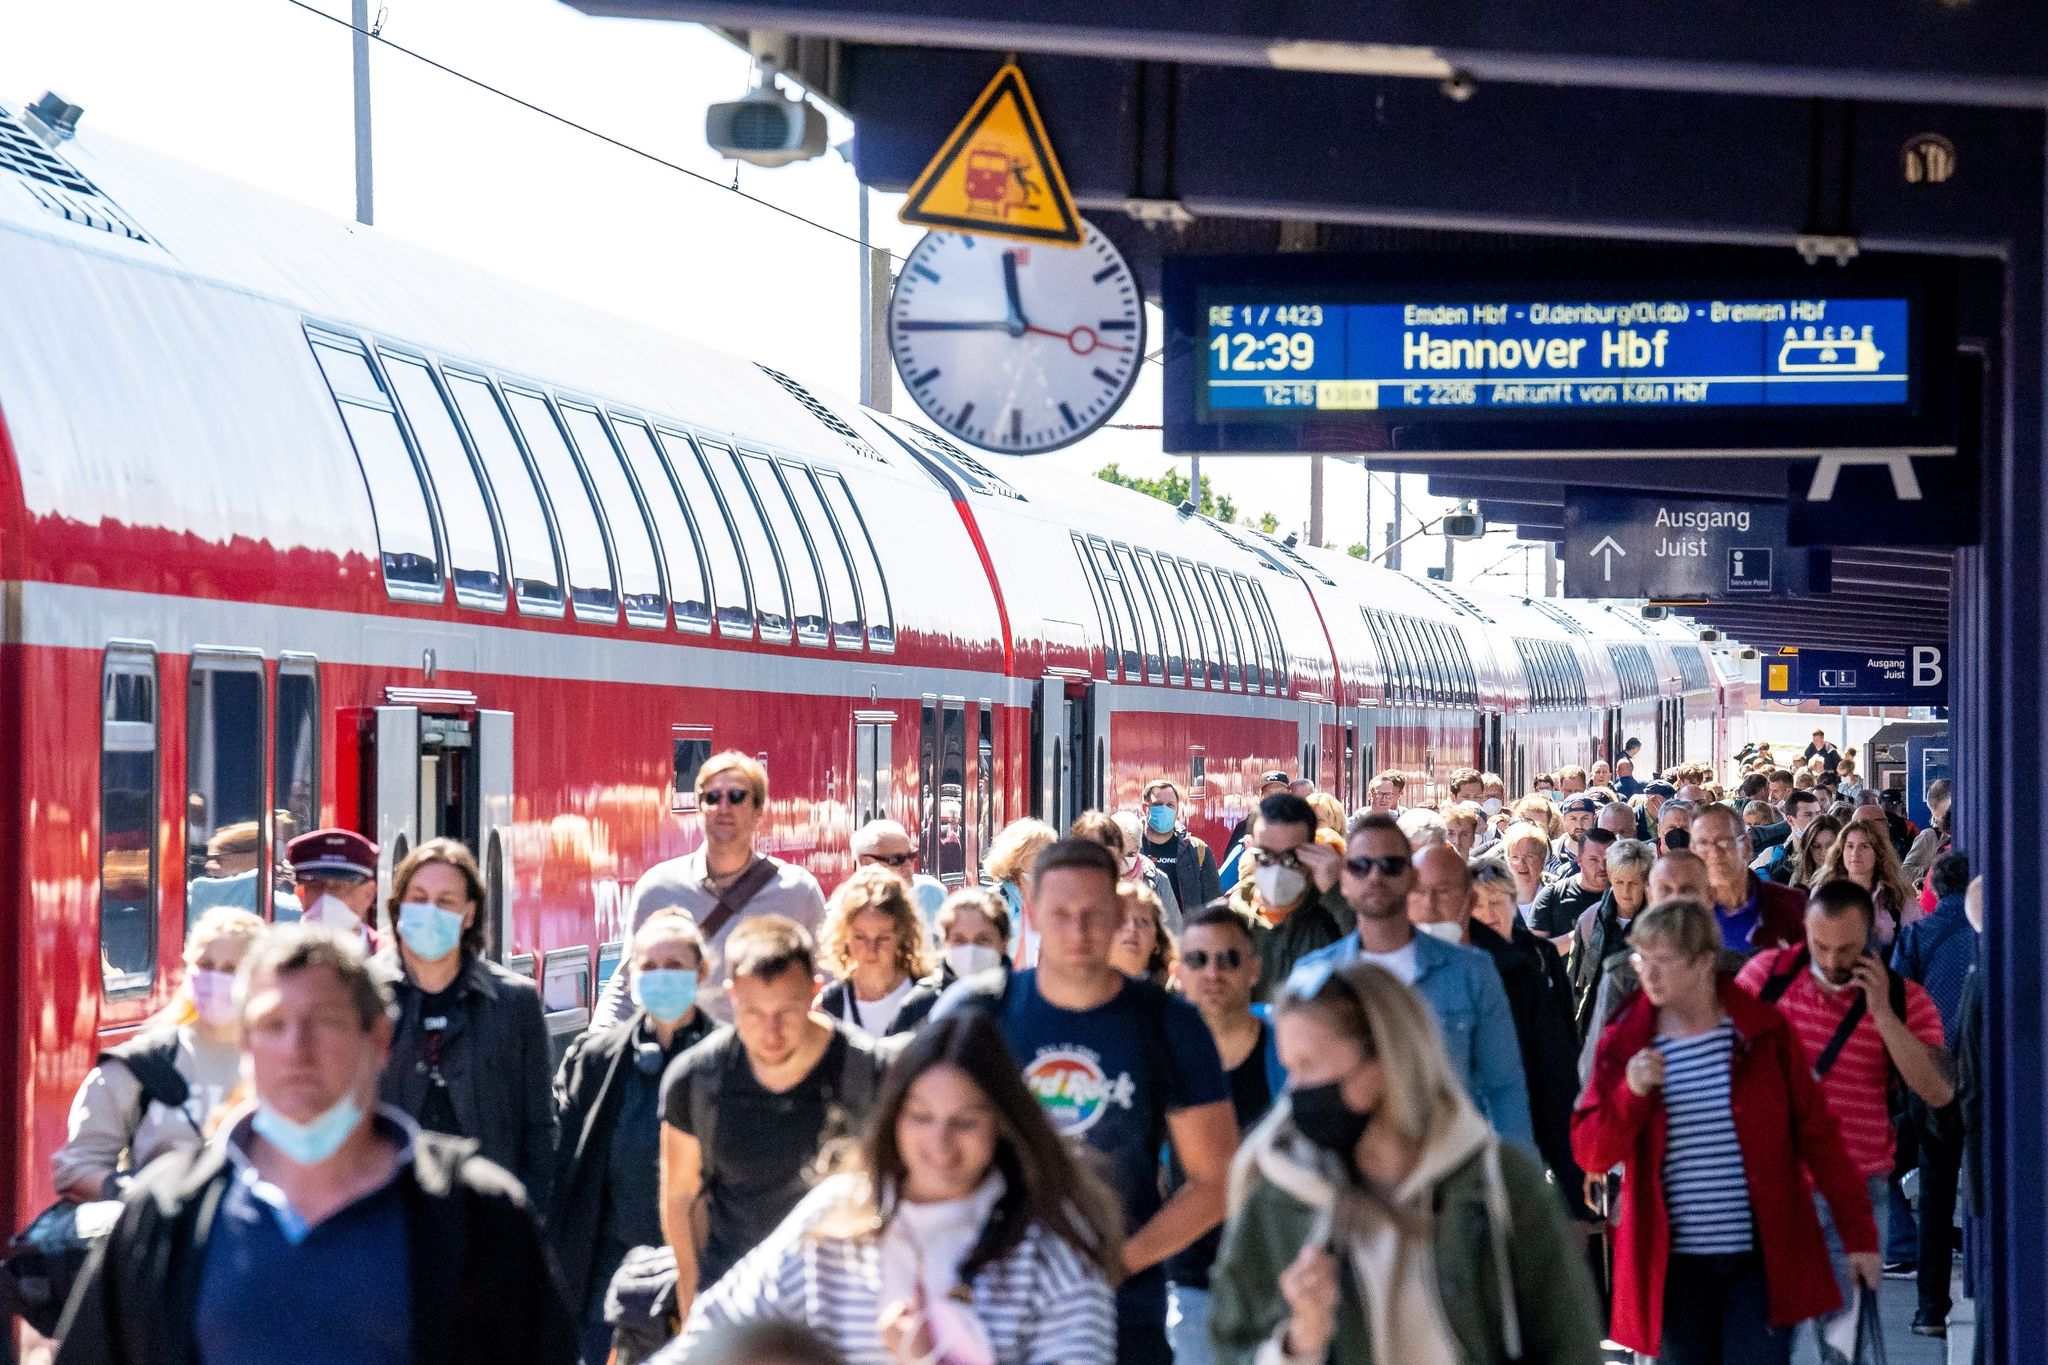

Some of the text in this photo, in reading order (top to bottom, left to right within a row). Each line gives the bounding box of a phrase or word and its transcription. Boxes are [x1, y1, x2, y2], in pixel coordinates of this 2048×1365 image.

[1209, 306, 1234, 327] RE
[1241, 305, 1252, 326] 1
[1275, 305, 1324, 327] 4423
[1404, 305, 1469, 326] Emden
[1473, 303, 1508, 326] Hbf
[1711, 301, 1786, 323] Bremen
[1790, 300, 1827, 322] Hbf
[1209, 332, 1315, 371] 12:39
[1403, 329, 1670, 370] Hannover Hbf
[1403, 384, 1423, 405] IC
[1492, 383, 1573, 404] Ankunft
[1579, 384, 1618, 403] von
[1673, 382, 1709, 402] Hbf
[1654, 507, 1750, 532] Ausgang
[1654, 537, 1708, 557] Juist
[1867, 659, 1906, 670] Ausgang
[1883, 670, 1906, 680] Juist
[1912, 646, 1943, 688] B
